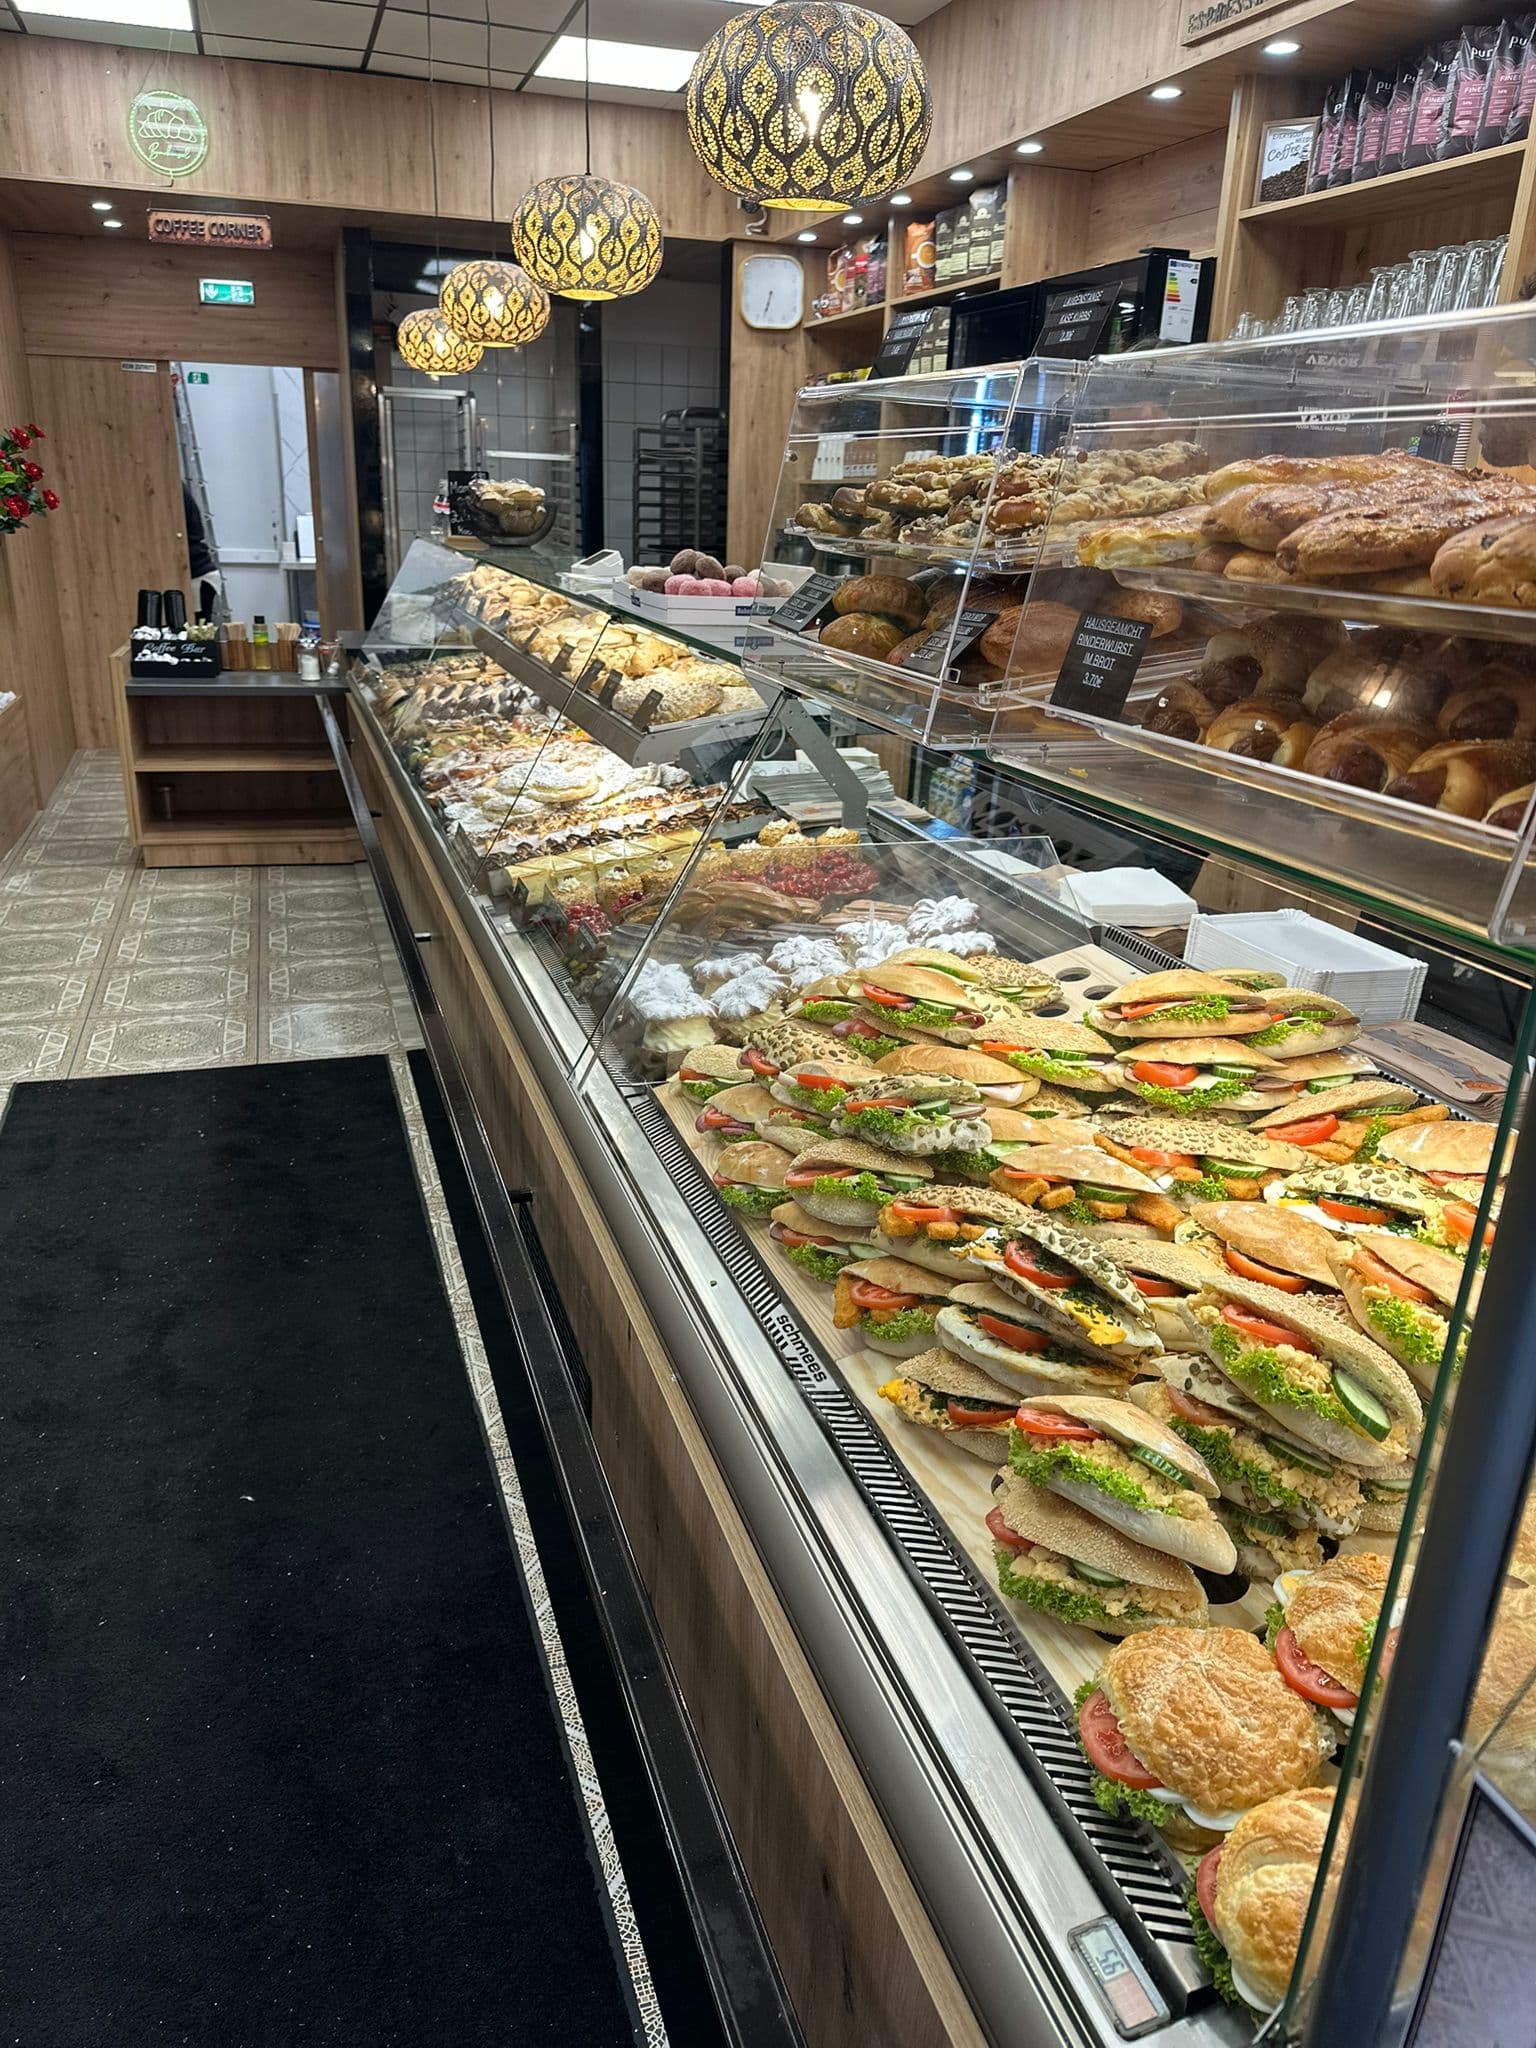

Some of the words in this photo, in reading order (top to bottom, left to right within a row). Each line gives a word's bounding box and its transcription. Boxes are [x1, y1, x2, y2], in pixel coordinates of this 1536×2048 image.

[1267, 142, 1301, 162] Coffee
[155, 218, 205, 235] COFFEE
[208, 221, 264, 239] CORNER
[1084, 616, 1144, 640] HAUSGEAMCHT
[1076, 633, 1134, 657] RINDERWURST
[1093, 655, 1116, 671] BROT
[776, 1314, 828, 1382] schmees
